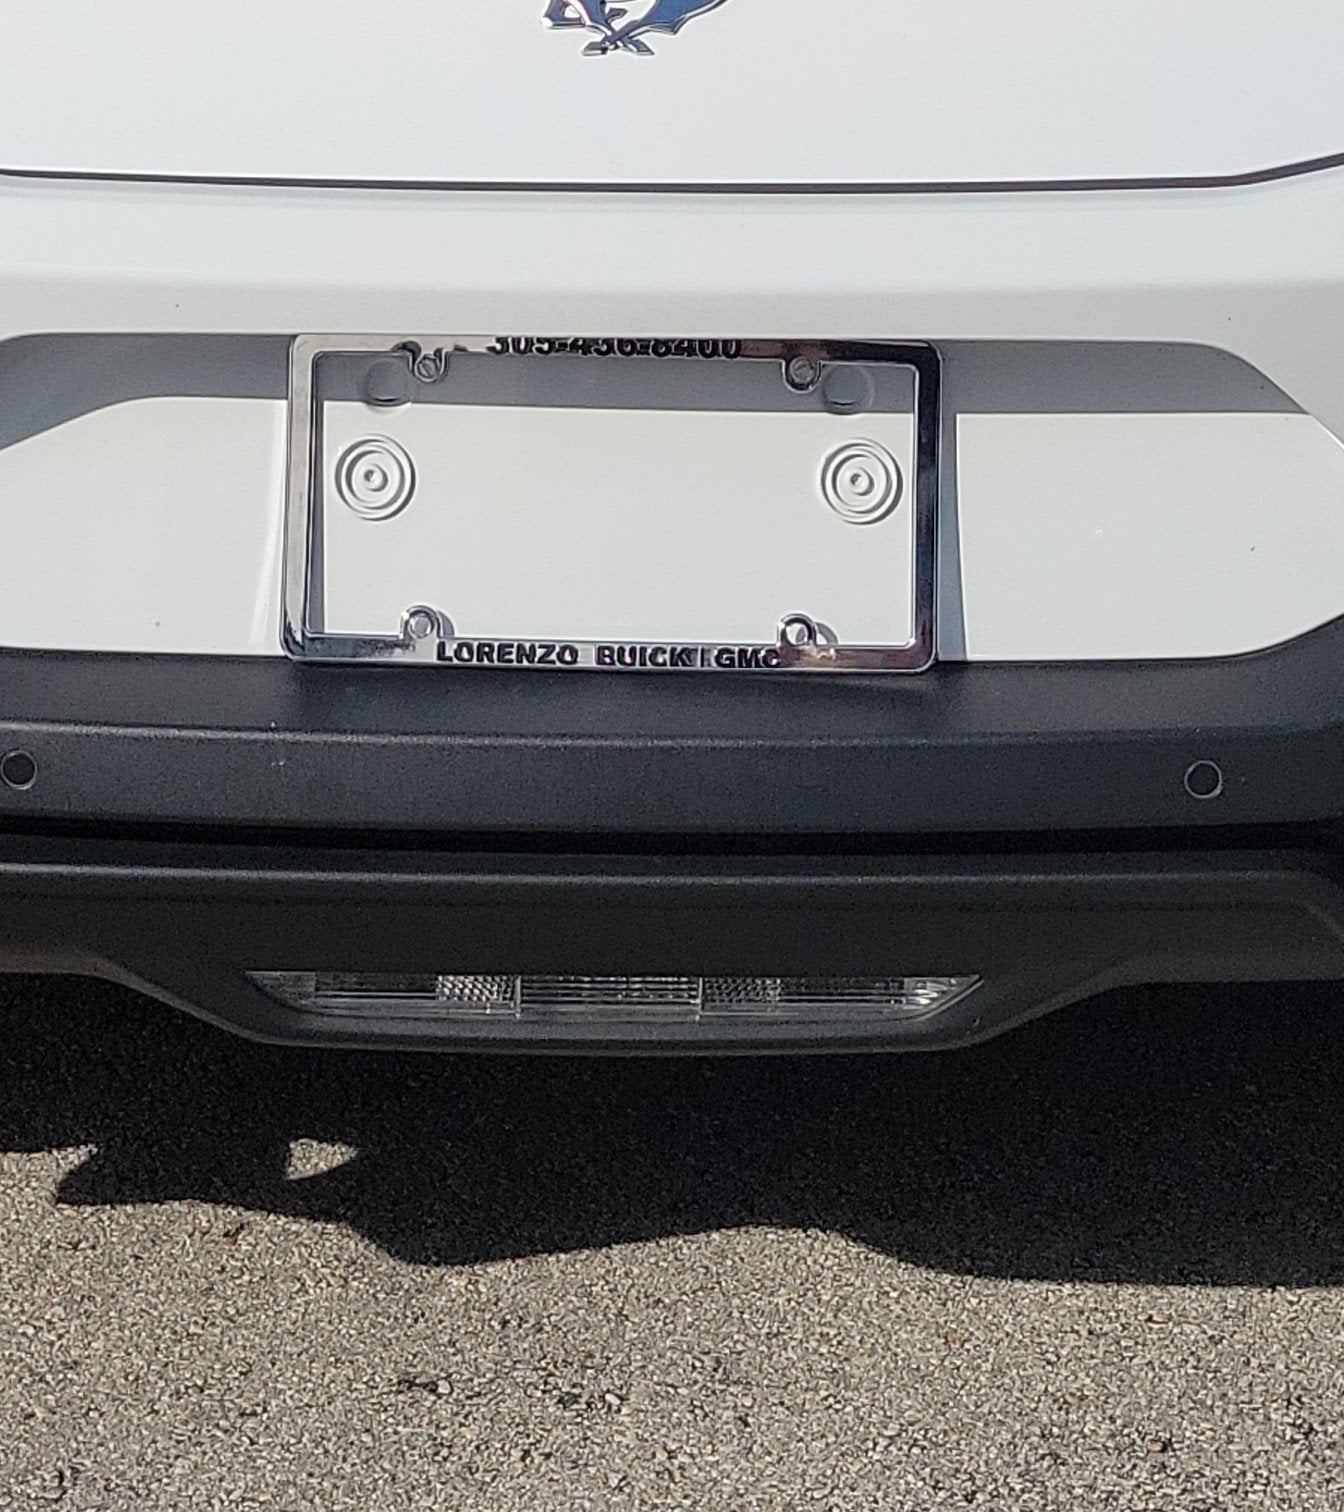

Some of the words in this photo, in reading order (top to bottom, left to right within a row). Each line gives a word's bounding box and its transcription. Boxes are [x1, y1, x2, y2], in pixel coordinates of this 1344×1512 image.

[436, 640, 579, 665] LORENZO
[595, 645, 693, 668] BUICK
[714, 646, 782, 669] GMC
